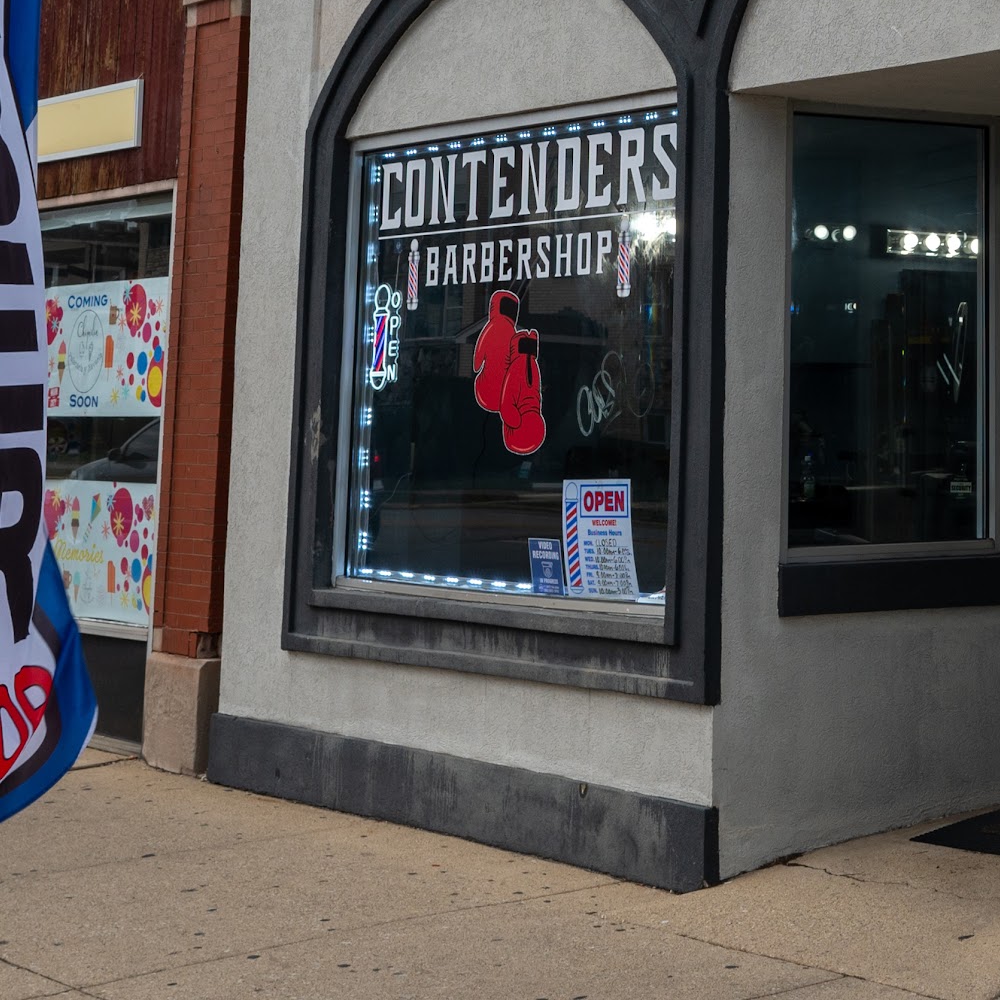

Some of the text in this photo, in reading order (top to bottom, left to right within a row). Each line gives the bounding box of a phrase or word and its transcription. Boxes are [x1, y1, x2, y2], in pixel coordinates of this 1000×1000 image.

[380, 123, 678, 230] CONTENDERS
[425, 230, 612, 287] BARBERSHOP
[68, 295, 108, 309] COMING
[387, 291, 401, 381] OPEN
[69, 394, 98, 408] SOON
[583, 490, 625, 512] OPEN
[592, 519, 617, 527] WELCOME!
[54, 539, 104, 564] Memories
[538, 541, 553, 550] VIDEO
[532, 550, 559, 560] RECORDING
